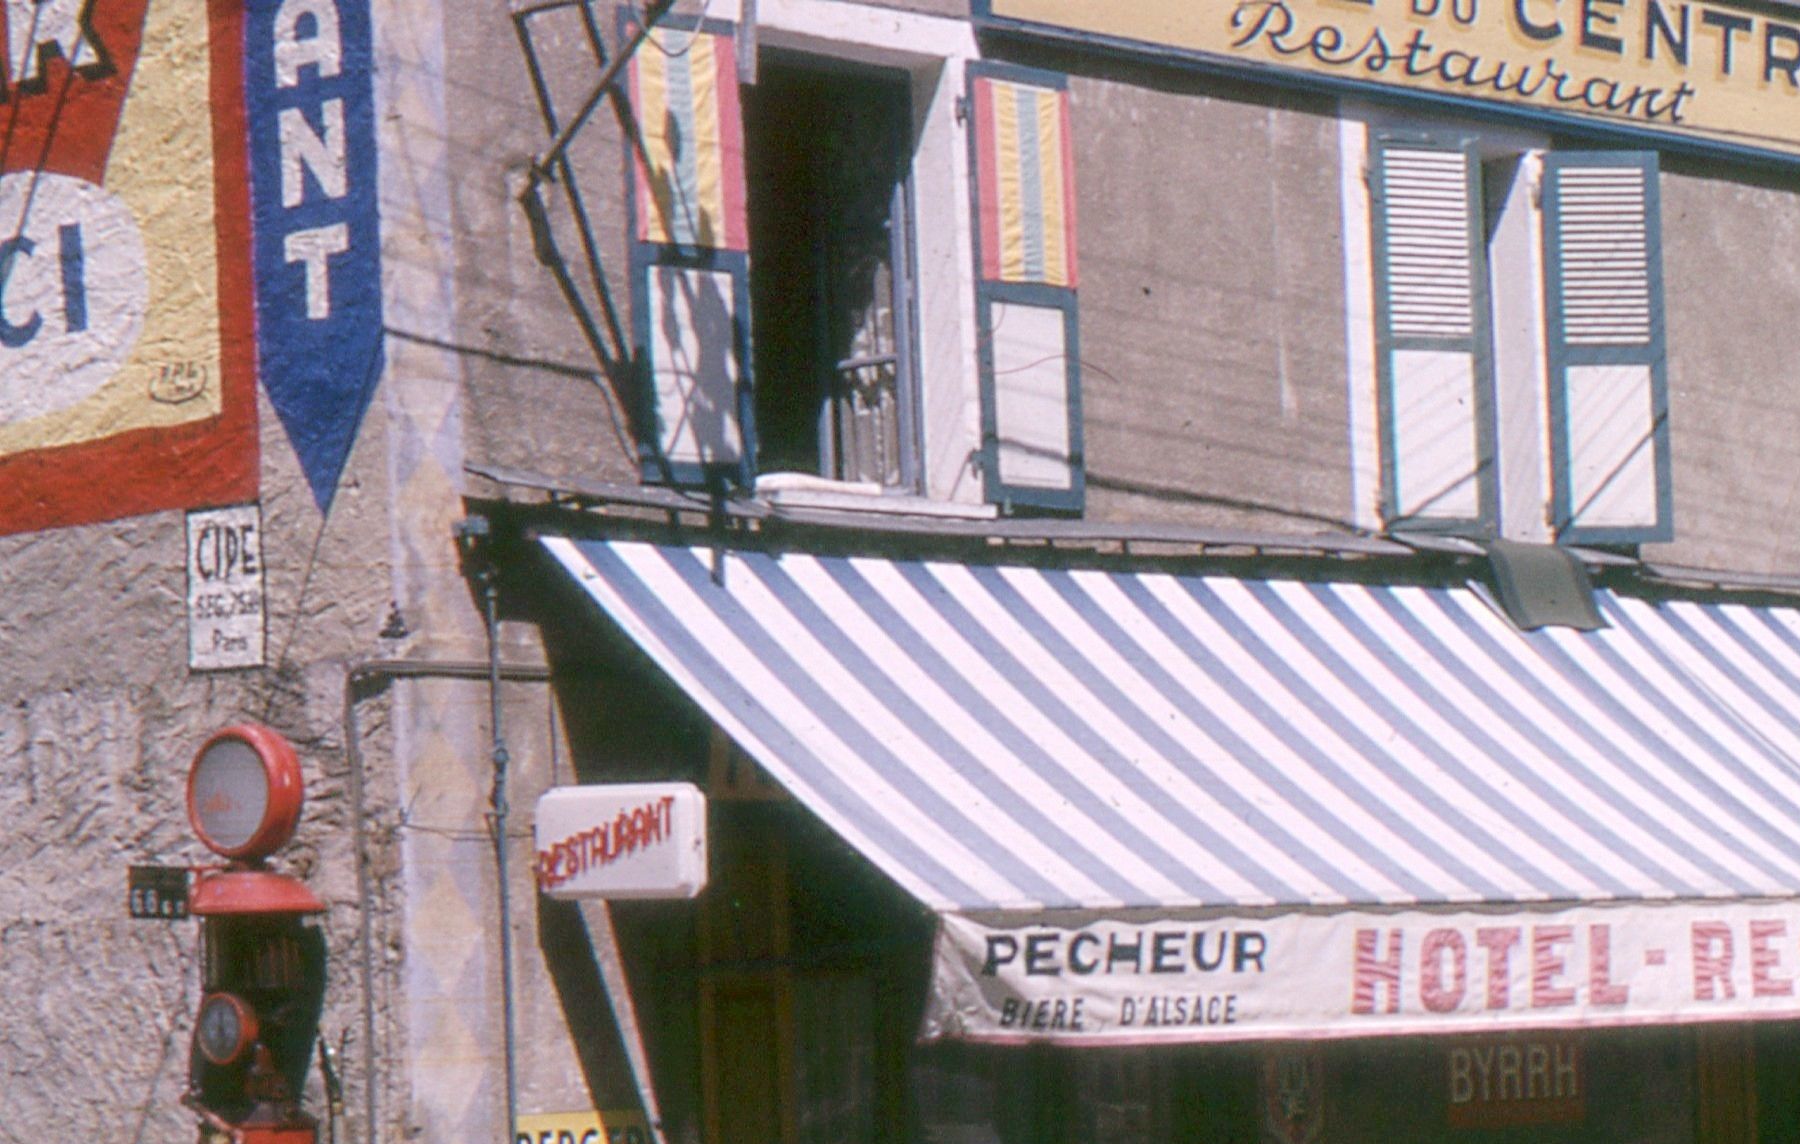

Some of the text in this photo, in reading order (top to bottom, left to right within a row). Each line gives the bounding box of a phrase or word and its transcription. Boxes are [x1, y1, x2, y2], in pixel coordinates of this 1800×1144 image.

[1231, 0, 1695, 120] Restaurant
[275, 0, 347, 320] ANT
[538, 796, 675, 889] RESTAURANT
[981, 930, 1267, 976] PECHEUR
[1000, 995, 1238, 1030] BIERE D'ALSACE
[1449, 1043, 1578, 1103] BYRRH
